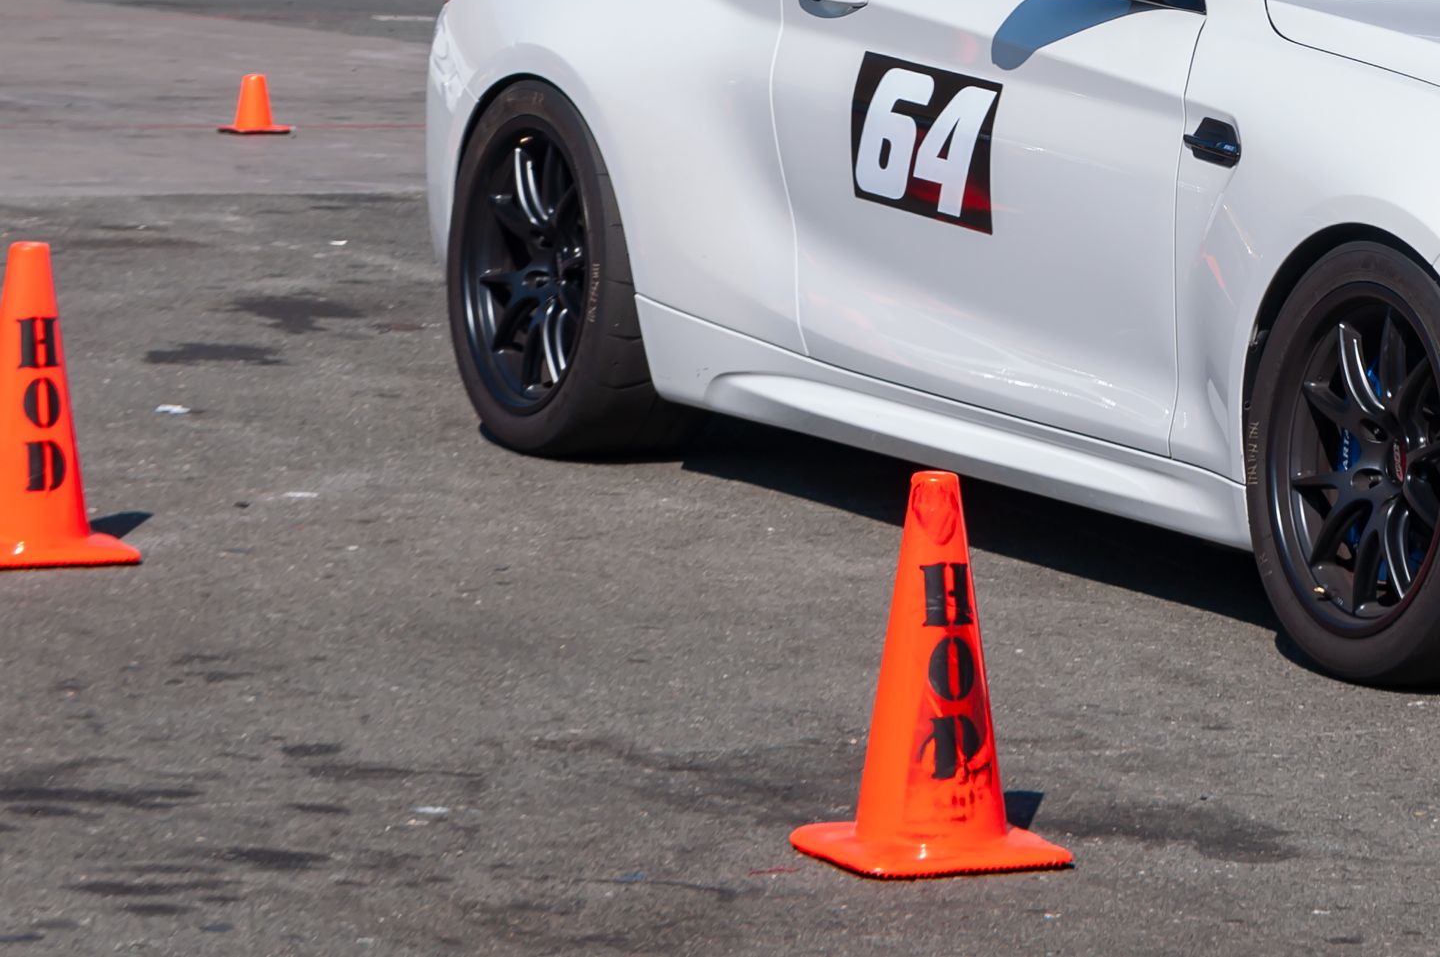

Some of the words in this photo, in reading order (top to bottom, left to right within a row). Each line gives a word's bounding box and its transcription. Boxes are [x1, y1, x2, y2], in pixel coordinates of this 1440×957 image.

[855, 67, 998, 218] 64
[17, 316, 67, 492] HOD
[918, 561, 987, 780] HOD
